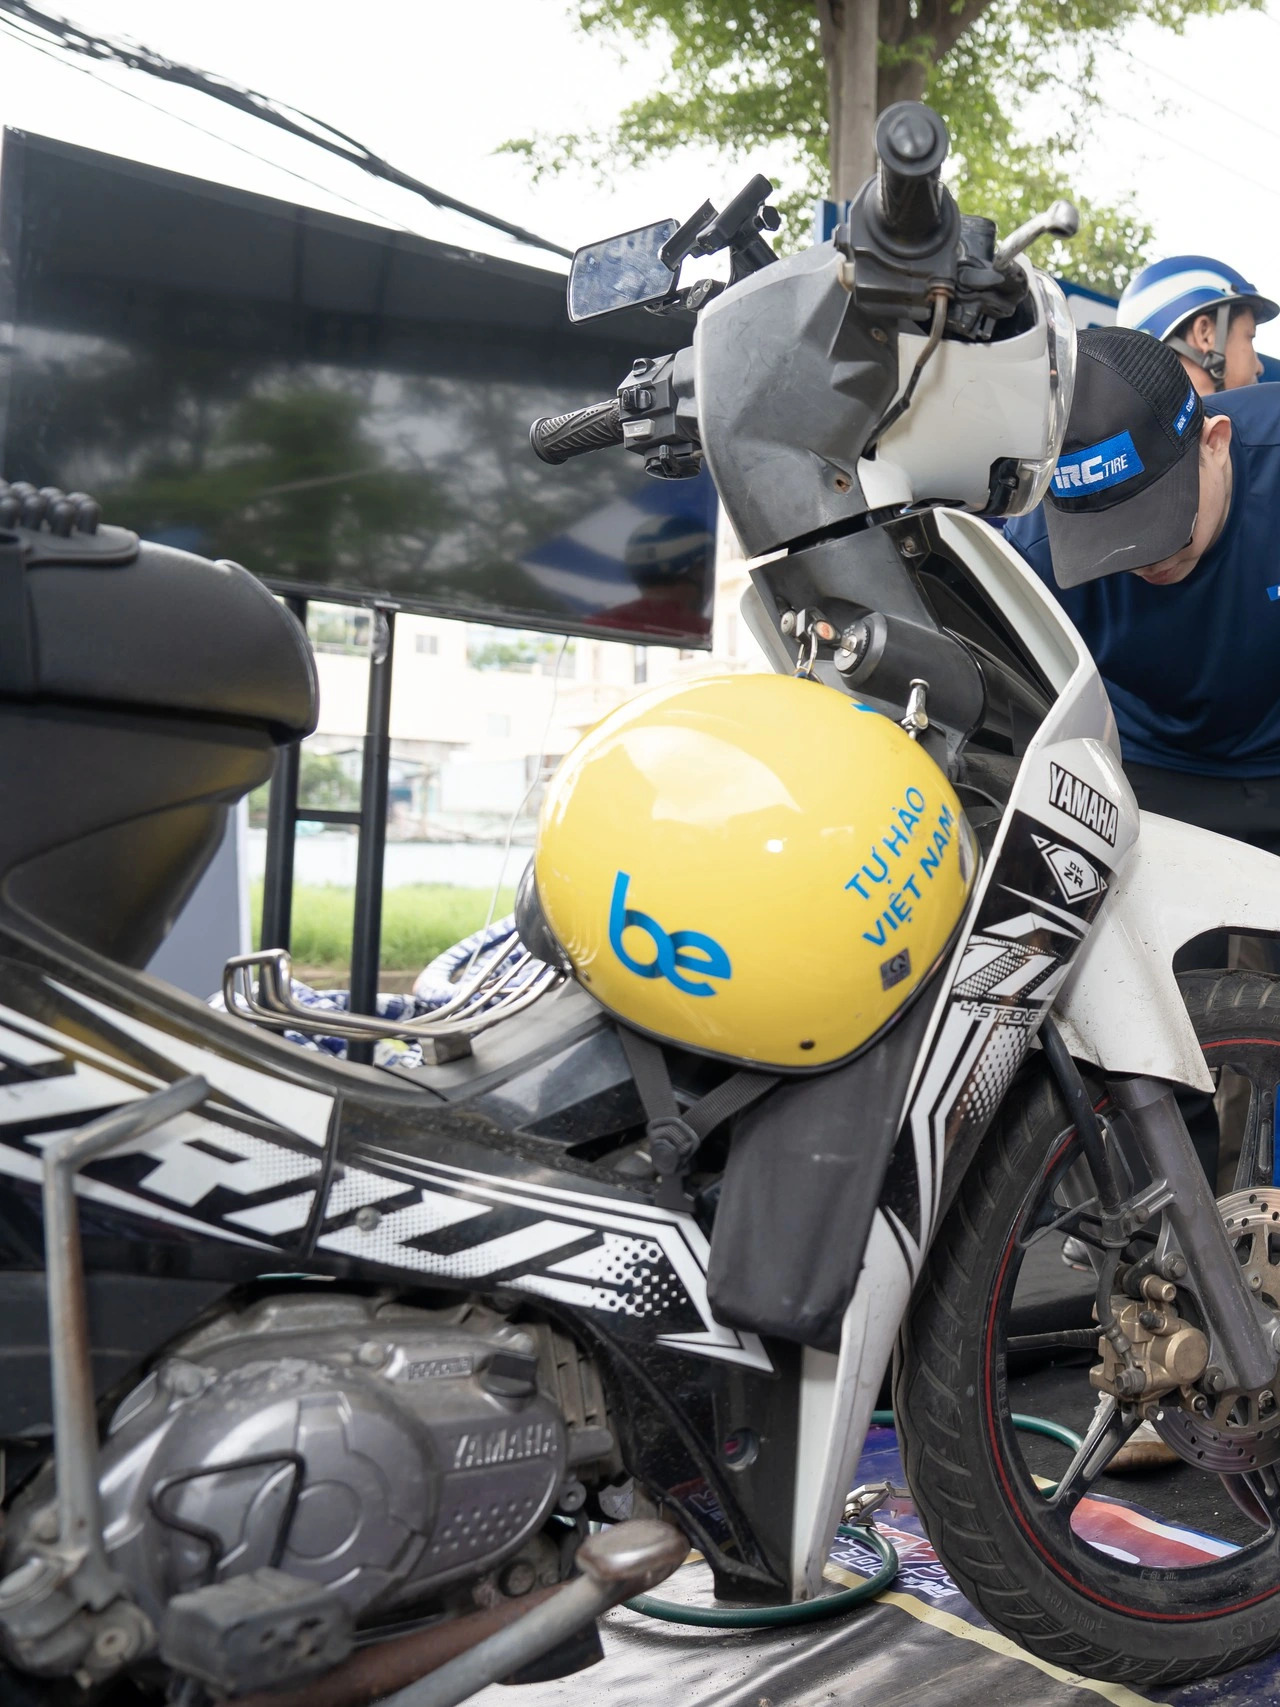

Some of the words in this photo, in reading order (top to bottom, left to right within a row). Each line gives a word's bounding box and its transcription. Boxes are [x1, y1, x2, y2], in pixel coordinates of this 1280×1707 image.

[1102, 453, 1129, 478] TIRE
[844, 845, 893, 900] TỰ
[882, 786, 926, 858] HÀO
[1050, 763, 1117, 846] YAMAHA
[862, 873, 922, 947] VIỆT
[919, 803, 956, 880] NAM
[608, 869, 732, 998] be
[454, 1422, 558, 1469] YAMAHA
